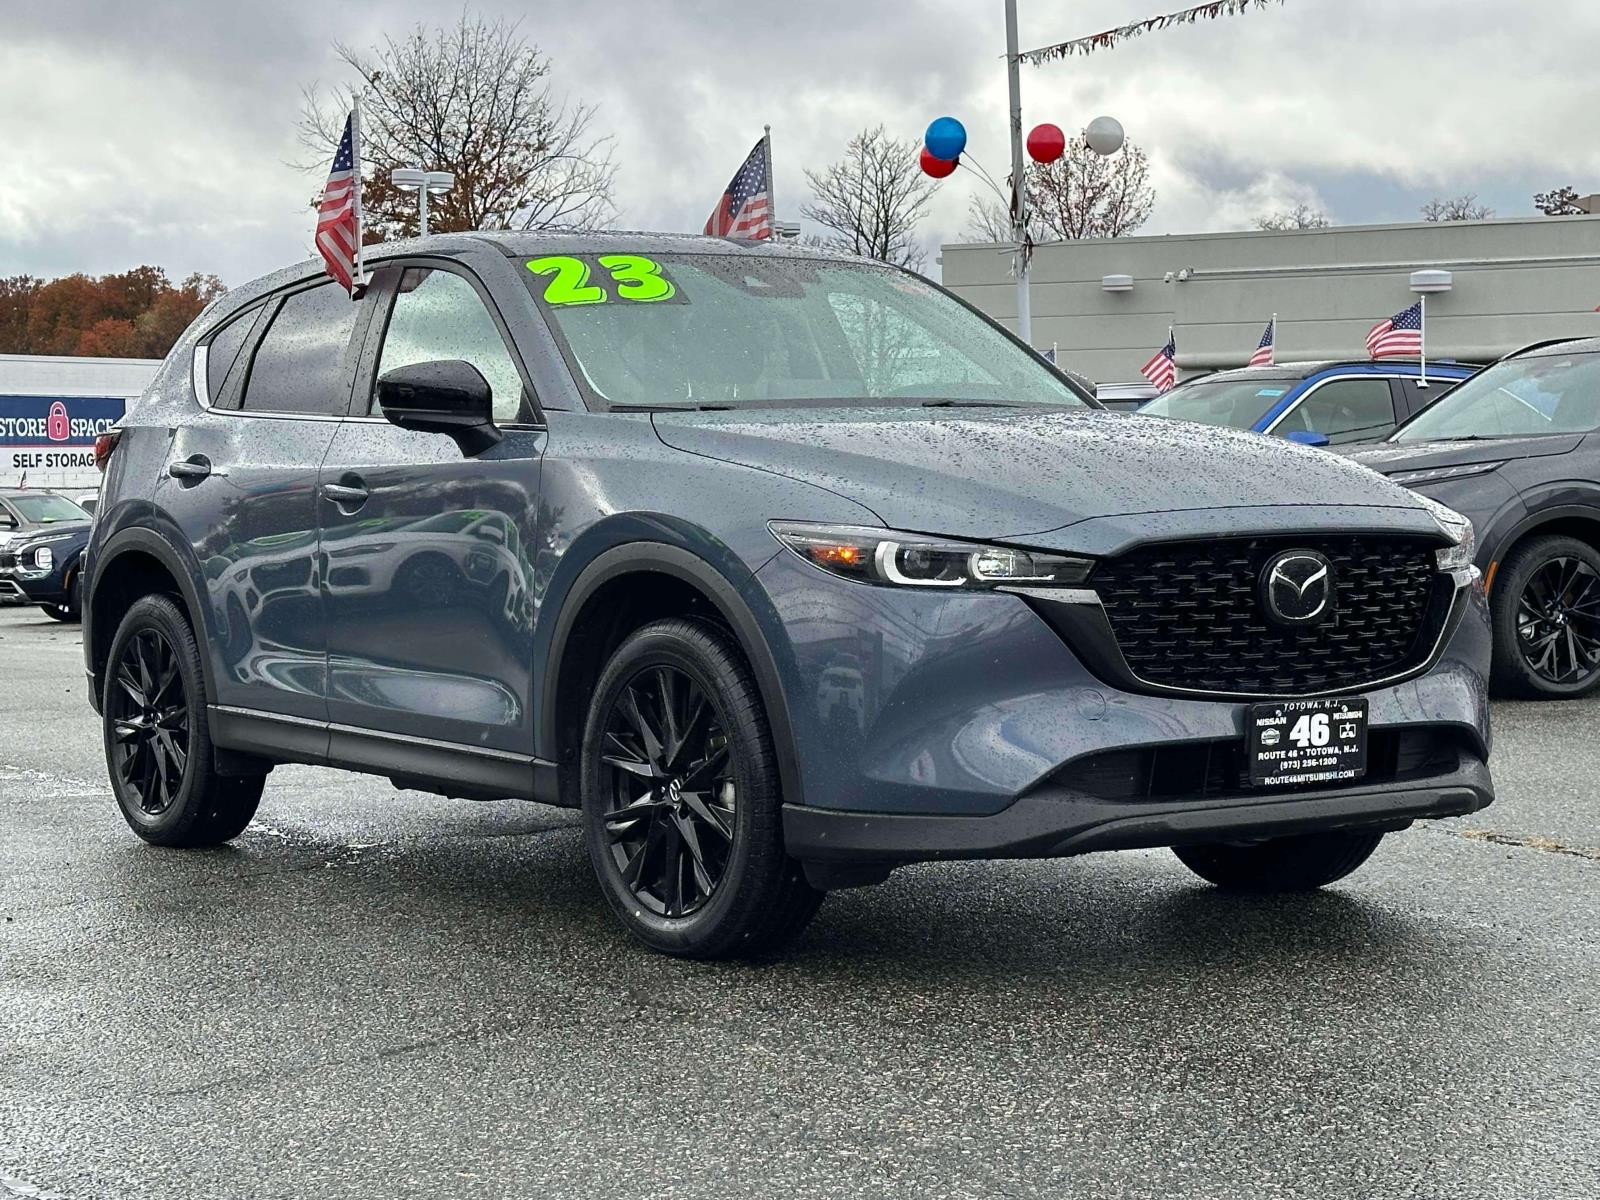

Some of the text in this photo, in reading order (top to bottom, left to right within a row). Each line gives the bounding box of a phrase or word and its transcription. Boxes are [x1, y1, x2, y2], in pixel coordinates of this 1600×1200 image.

[526, 255, 676, 305] 23
[0, 418, 47, 437] STORE
[13, 453, 95, 468] SELF STORAG
[1256, 717, 1287, 726] NISSAN
[1333, 711, 1363, 720] MITSUBISHI
[1289, 713, 1330, 747] 46
[1258, 751, 1286, 760] ROUTE
[1288, 750, 1298, 758] 46
[1280, 760, 1300, 770] (973)
[1264, 770, 1355, 785] ROUTE46MITSUBISHI.COM
